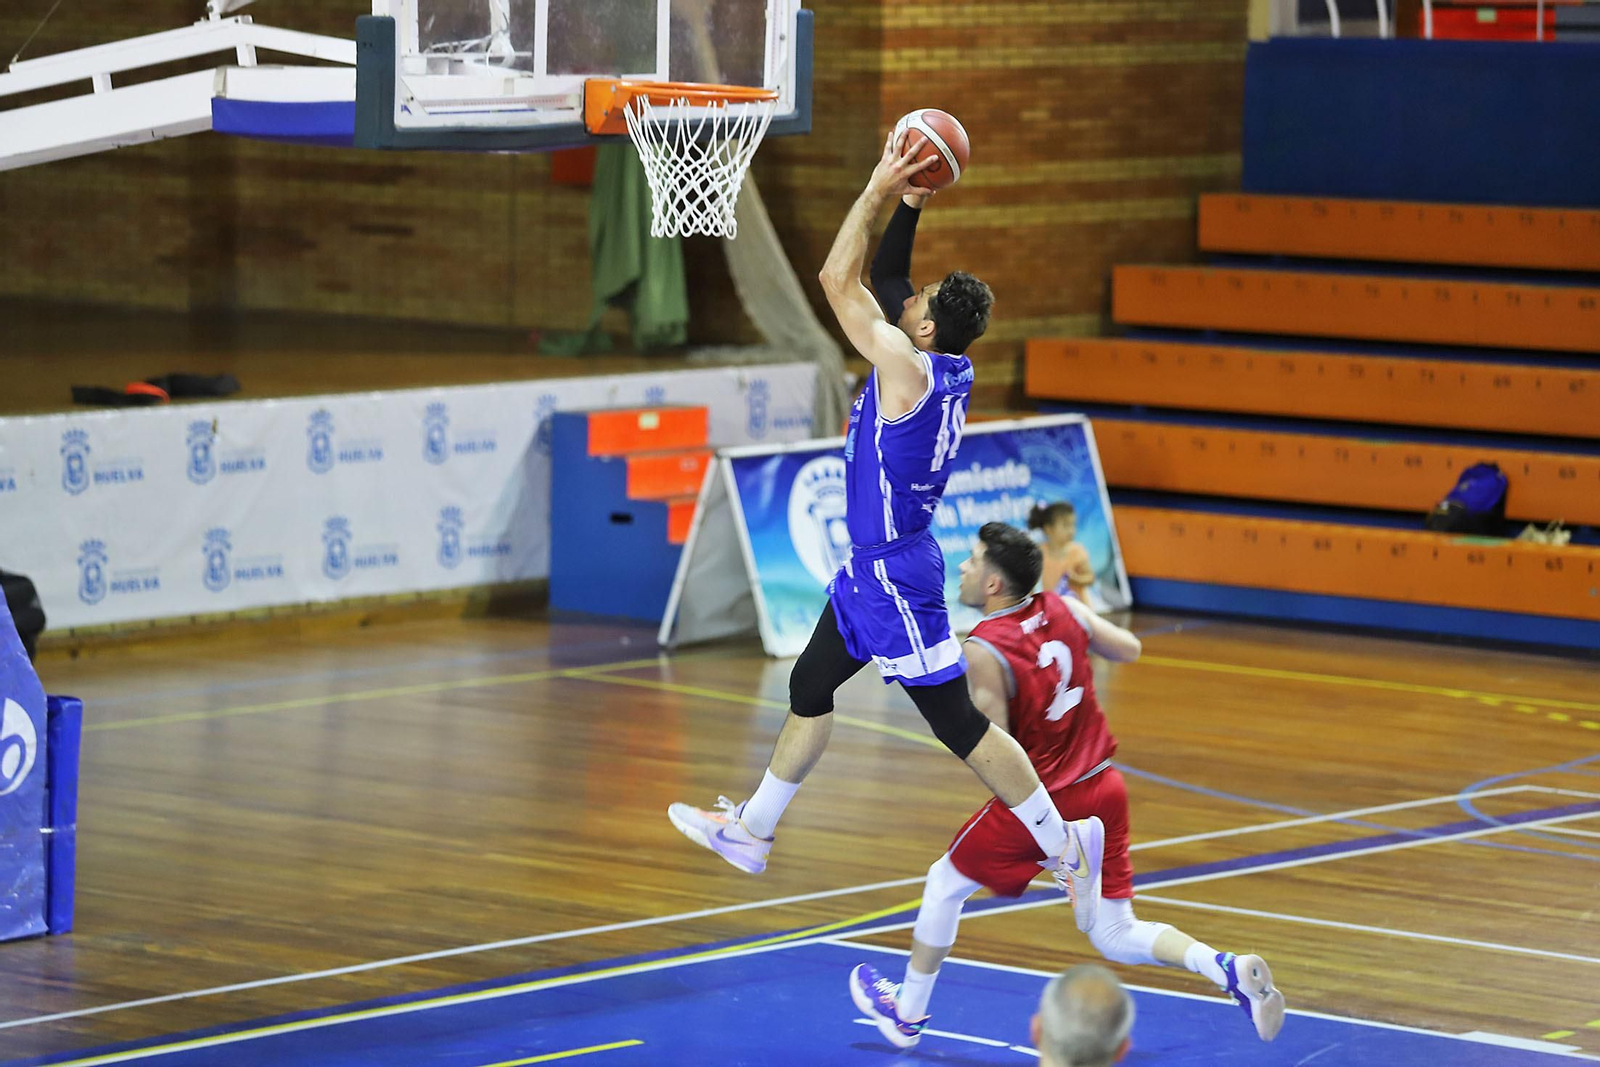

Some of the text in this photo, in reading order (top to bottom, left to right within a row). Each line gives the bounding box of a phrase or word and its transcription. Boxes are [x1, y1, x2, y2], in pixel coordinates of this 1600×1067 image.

[93, 468, 144, 484] HUELVA
[110, 577, 160, 594] HUELVA
[1036, 640, 1085, 721] 2
